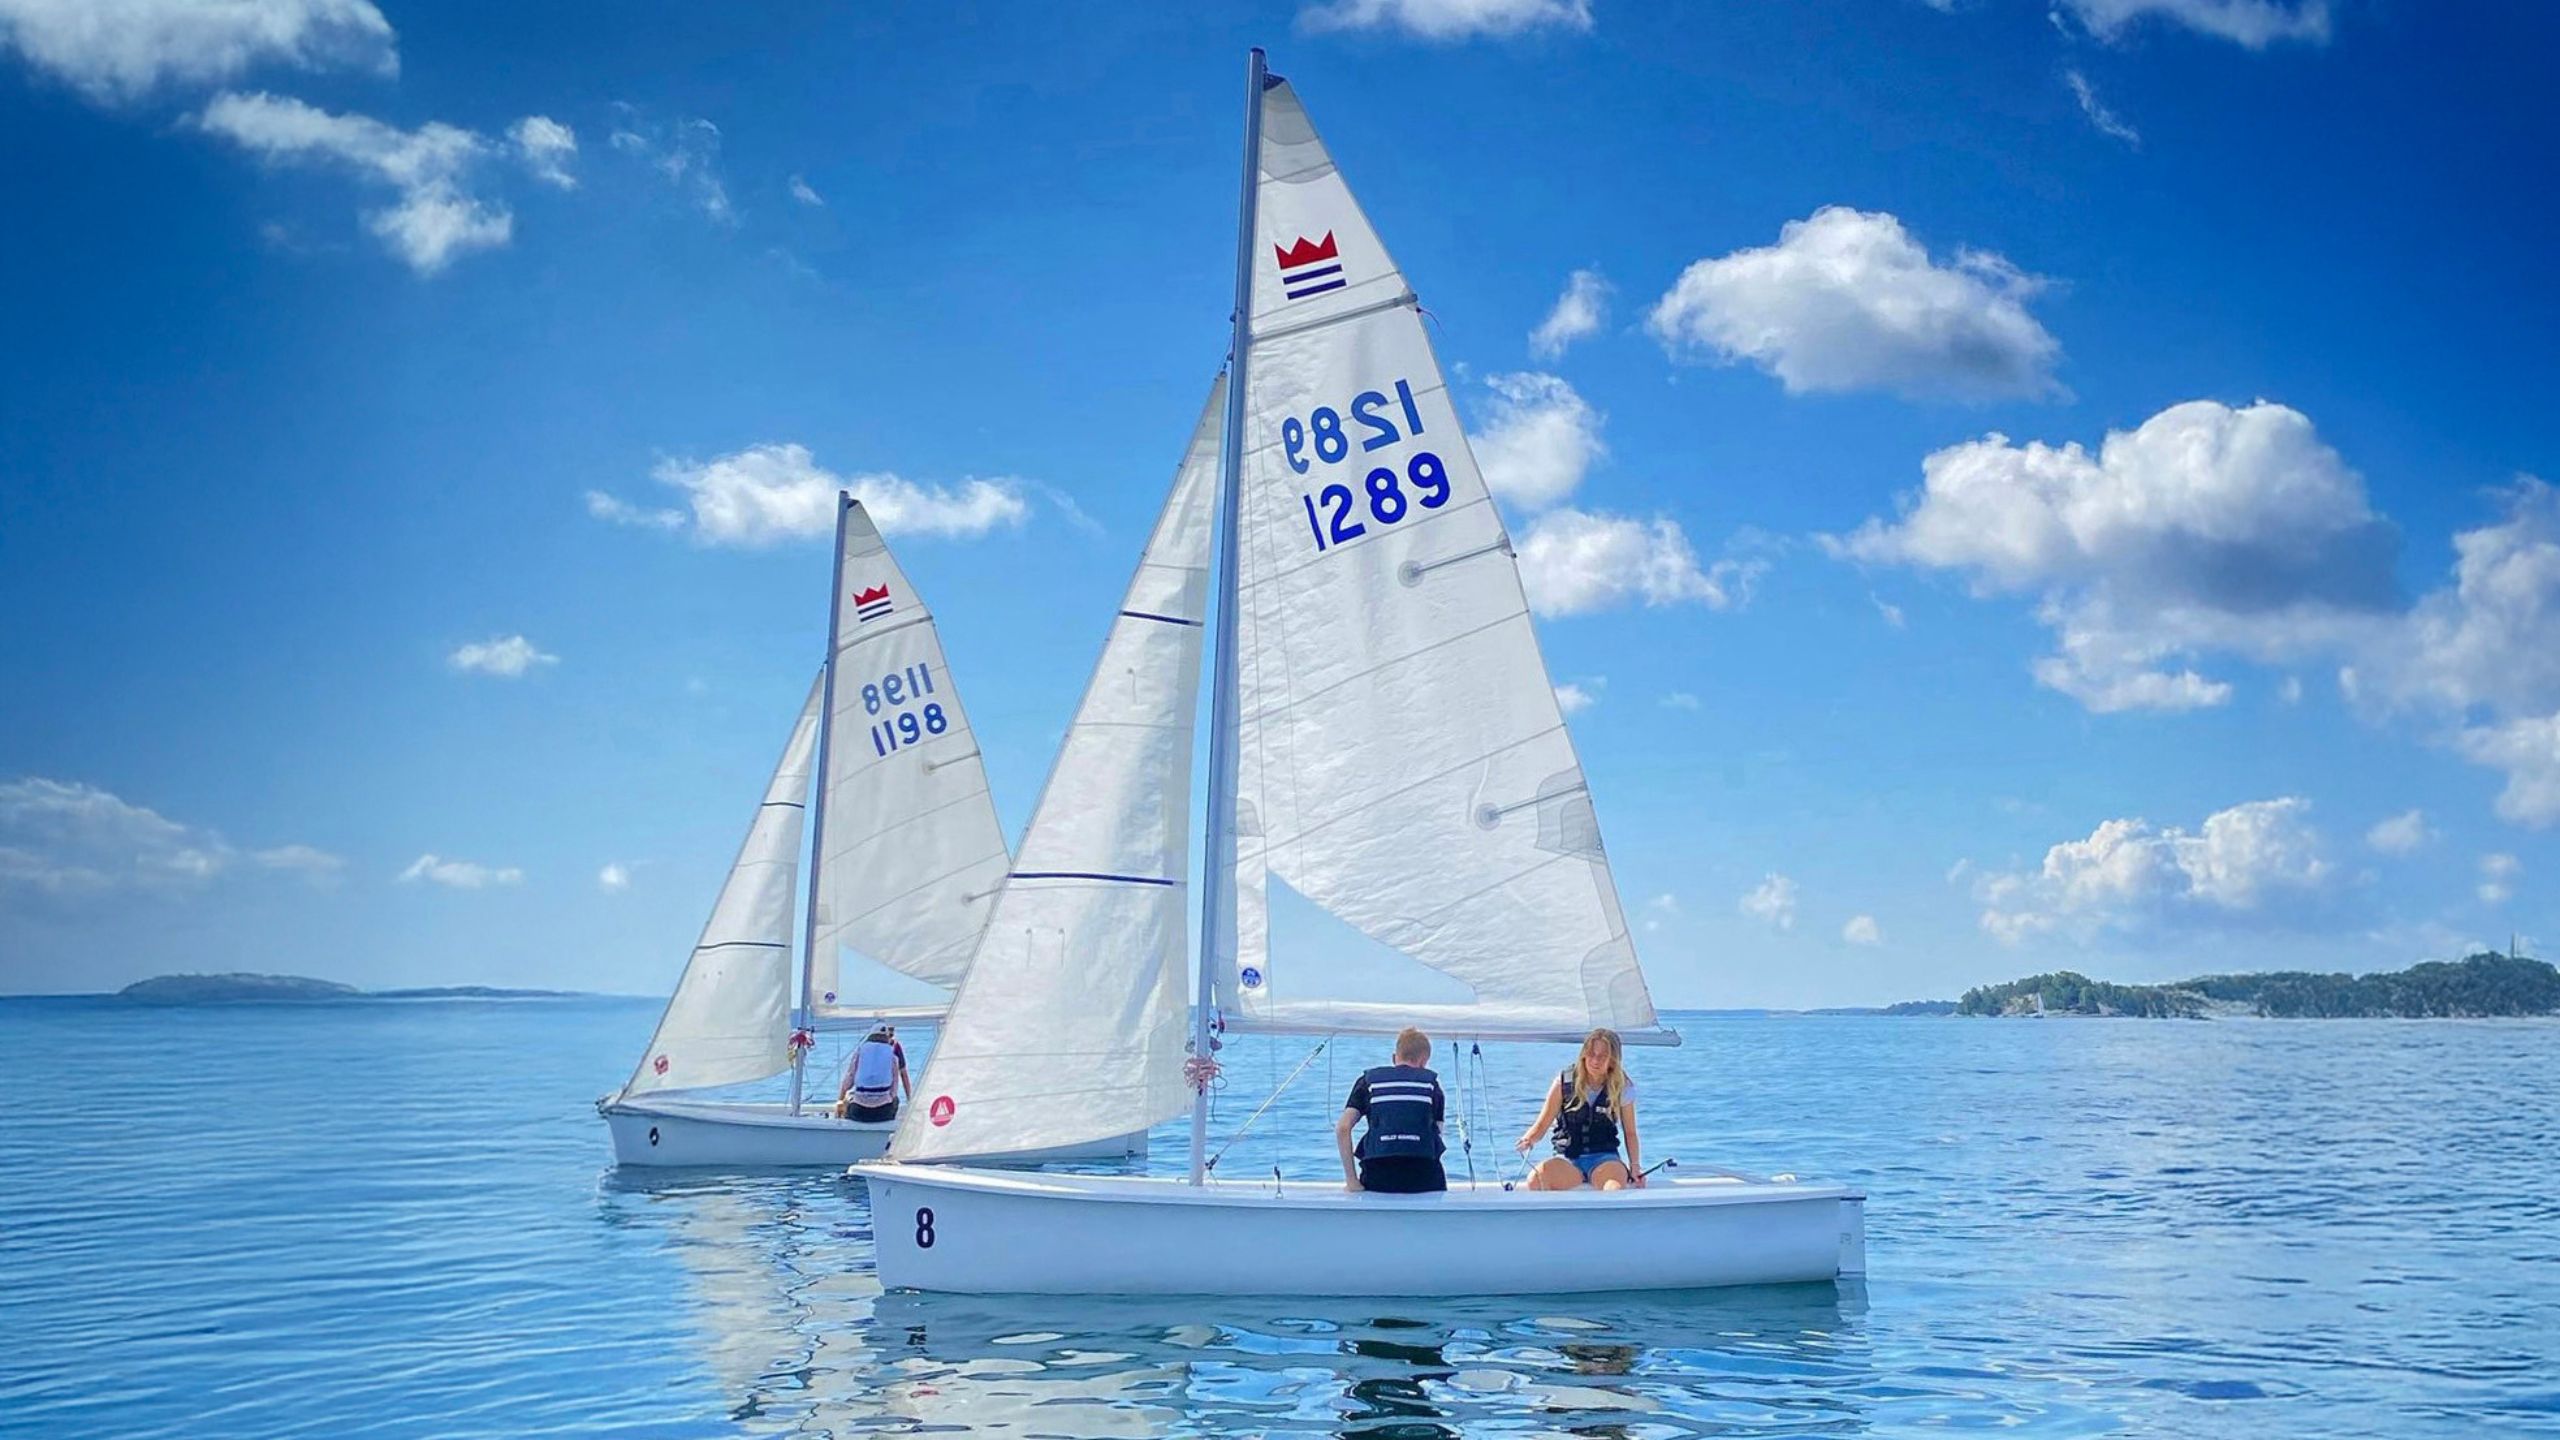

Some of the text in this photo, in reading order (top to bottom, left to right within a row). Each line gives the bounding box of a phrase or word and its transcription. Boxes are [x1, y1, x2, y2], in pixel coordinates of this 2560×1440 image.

[1303, 452, 1451, 552] 1289
[871, 703, 947, 757] 1198
[916, 1207, 935, 1249] 8
